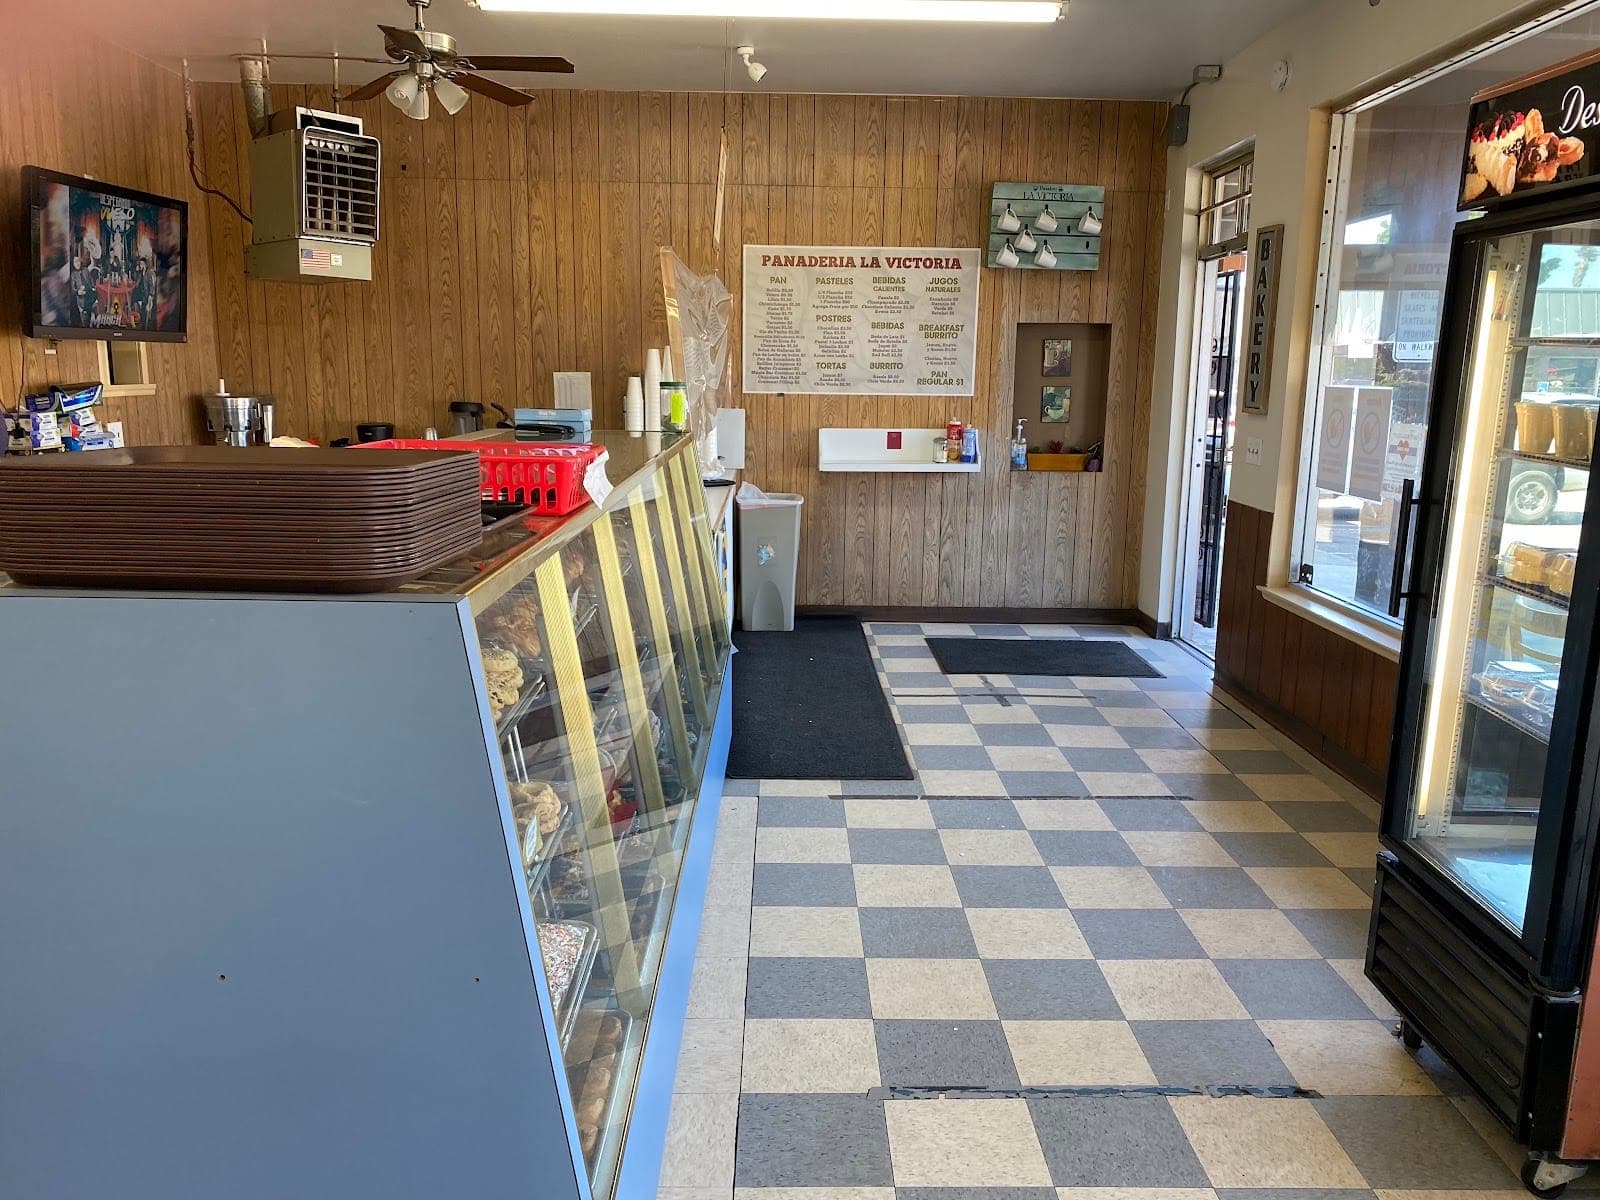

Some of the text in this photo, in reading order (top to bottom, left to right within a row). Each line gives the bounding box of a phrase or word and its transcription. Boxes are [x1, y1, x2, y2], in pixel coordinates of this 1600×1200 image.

[762, 255, 963, 270] PANADERIA LA VICTORIA
[770, 276, 787, 284] PAN
[815, 277, 854, 285] PASTELES
[872, 276, 906, 285] BEBIDAS
[929, 277, 959, 285] JUGOS
[815, 314, 852, 323] POSTRES
[1250, 238, 1272, 403] BAKERY
[871, 321, 905, 330] BEBIDAS
[918, 324, 965, 332] BREAKFAST
[924, 331, 959, 340] BURRITO
[815, 361, 848, 370] TORTAS
[869, 361, 904, 370] BURRITO
[931, 370, 948, 378] PAN
[916, 377, 965, 386] REGULAR $1
